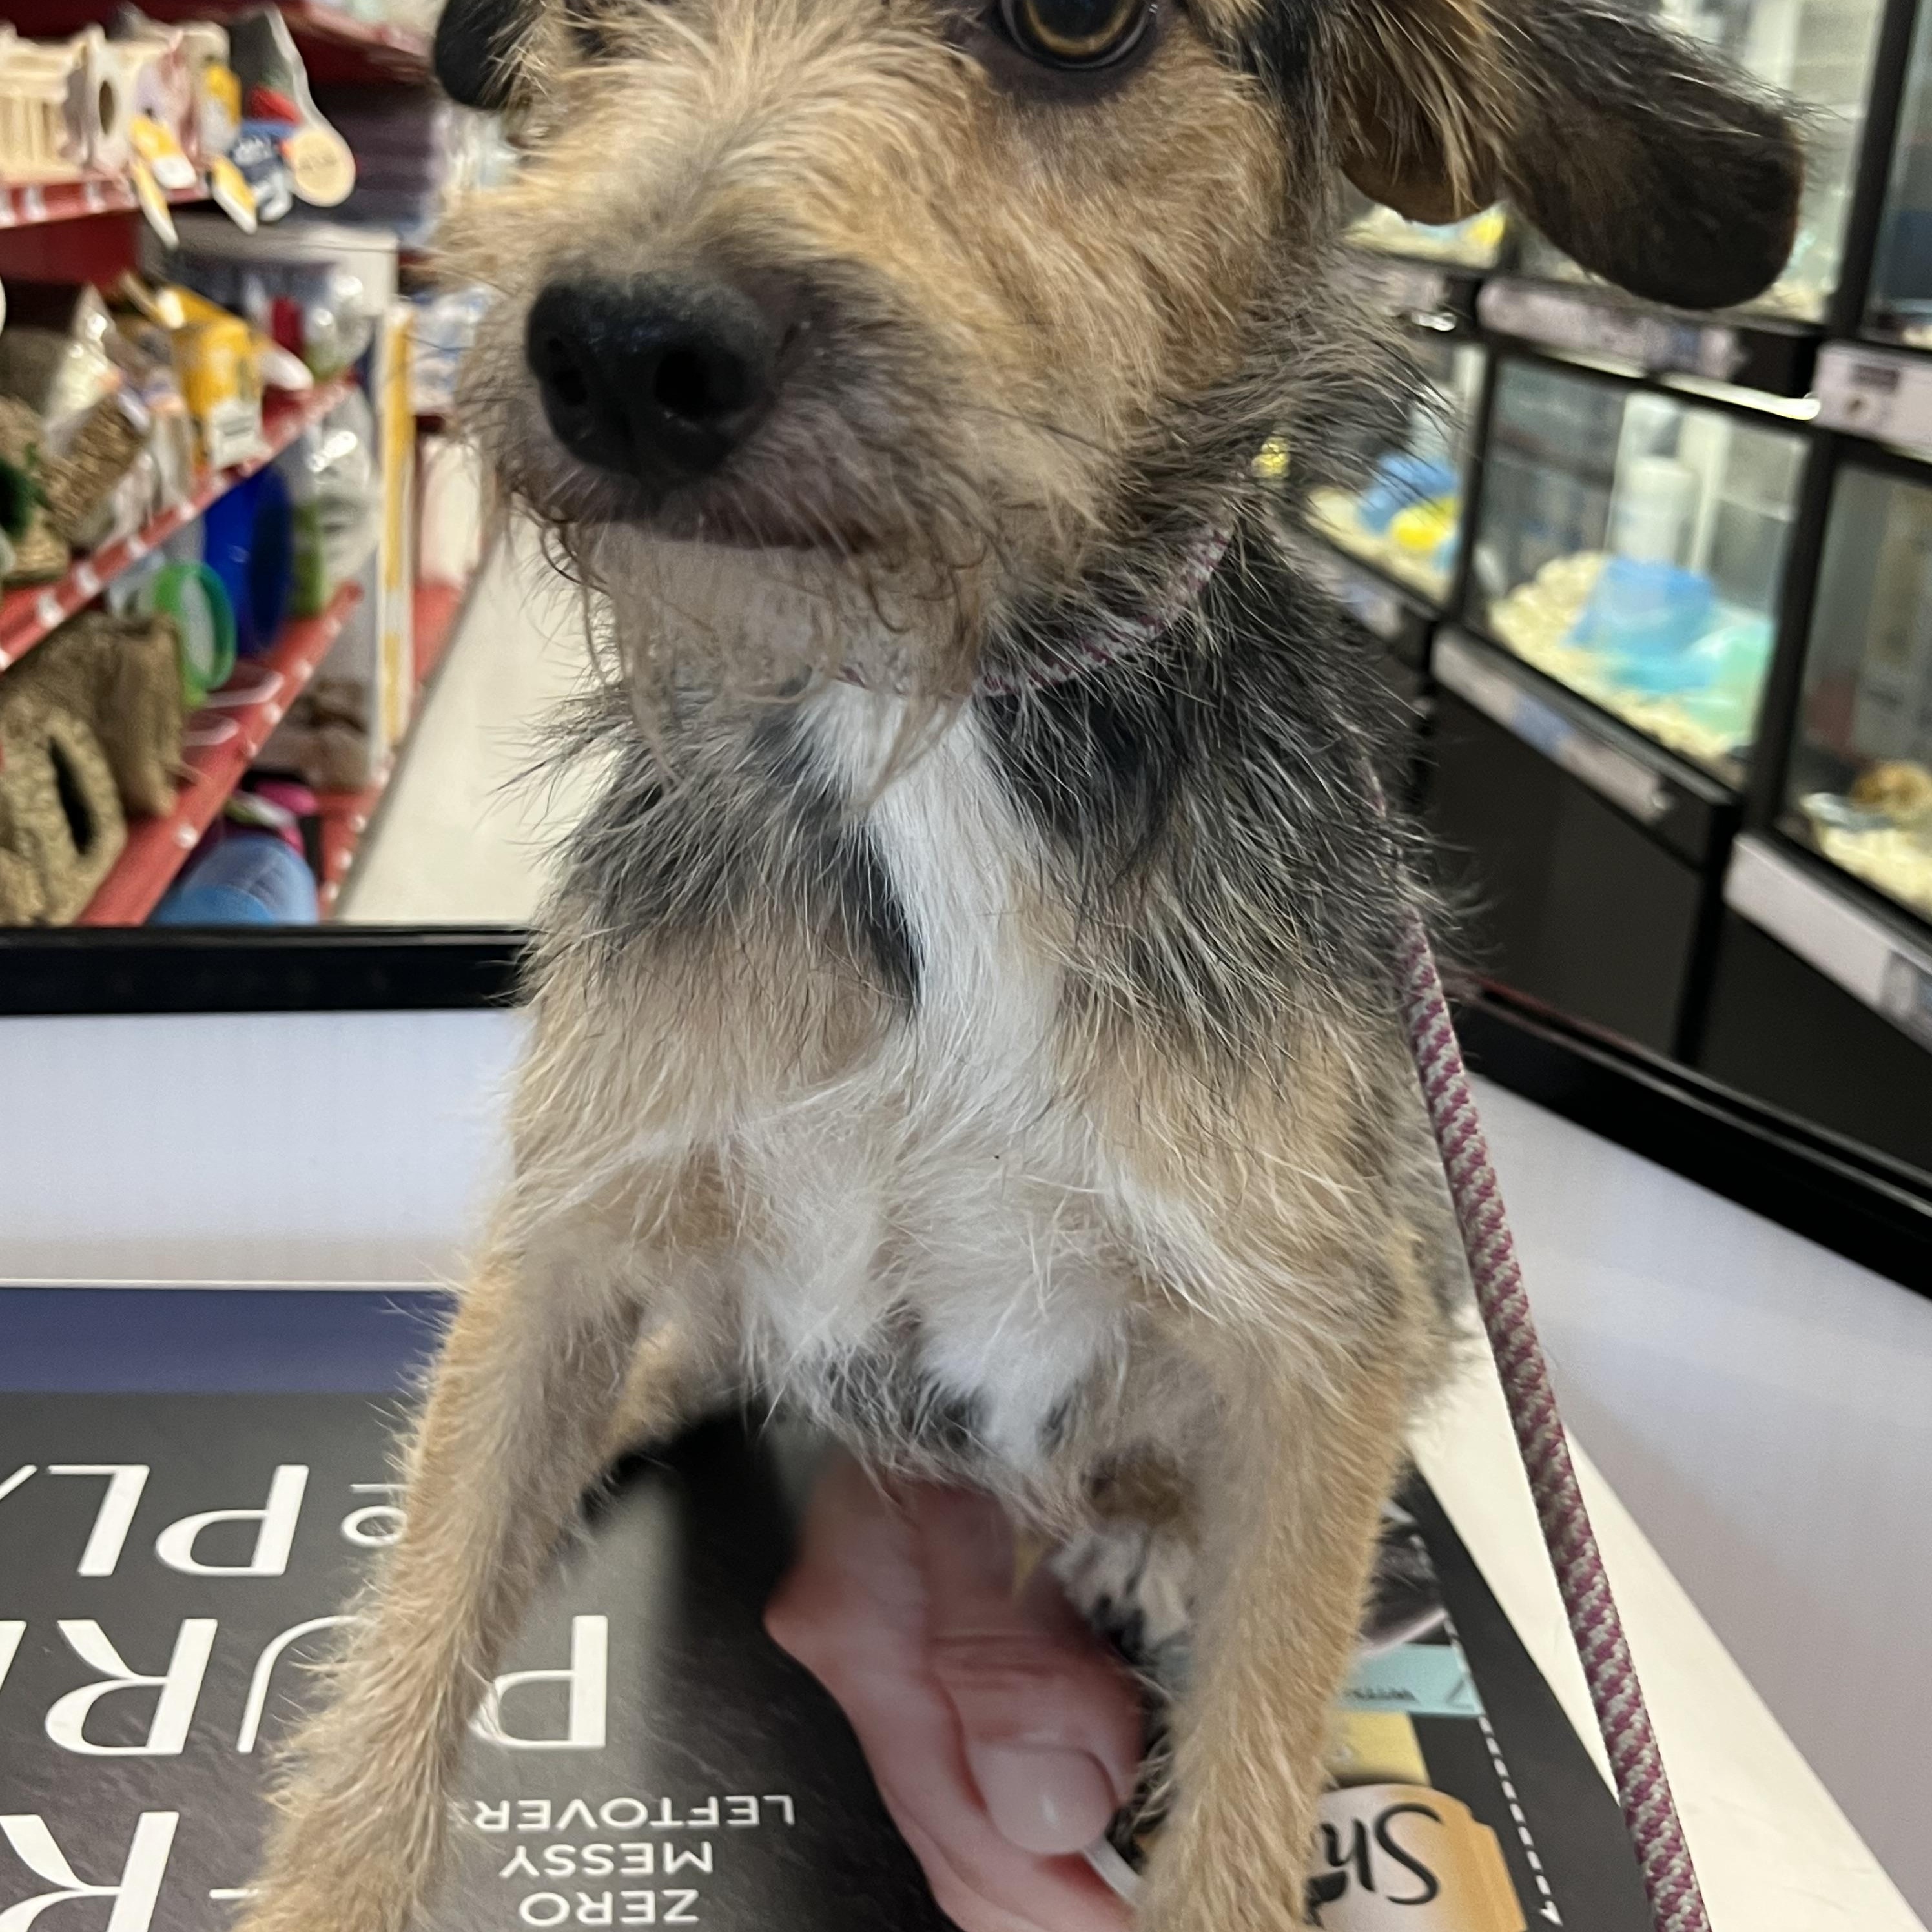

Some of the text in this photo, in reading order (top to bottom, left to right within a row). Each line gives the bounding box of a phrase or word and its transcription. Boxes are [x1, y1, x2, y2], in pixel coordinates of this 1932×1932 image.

[0, 1464, 310, 1577] PL
[498, 1841, 713, 1878] MESSY
[519, 1888, 700, 1927] ZERO
